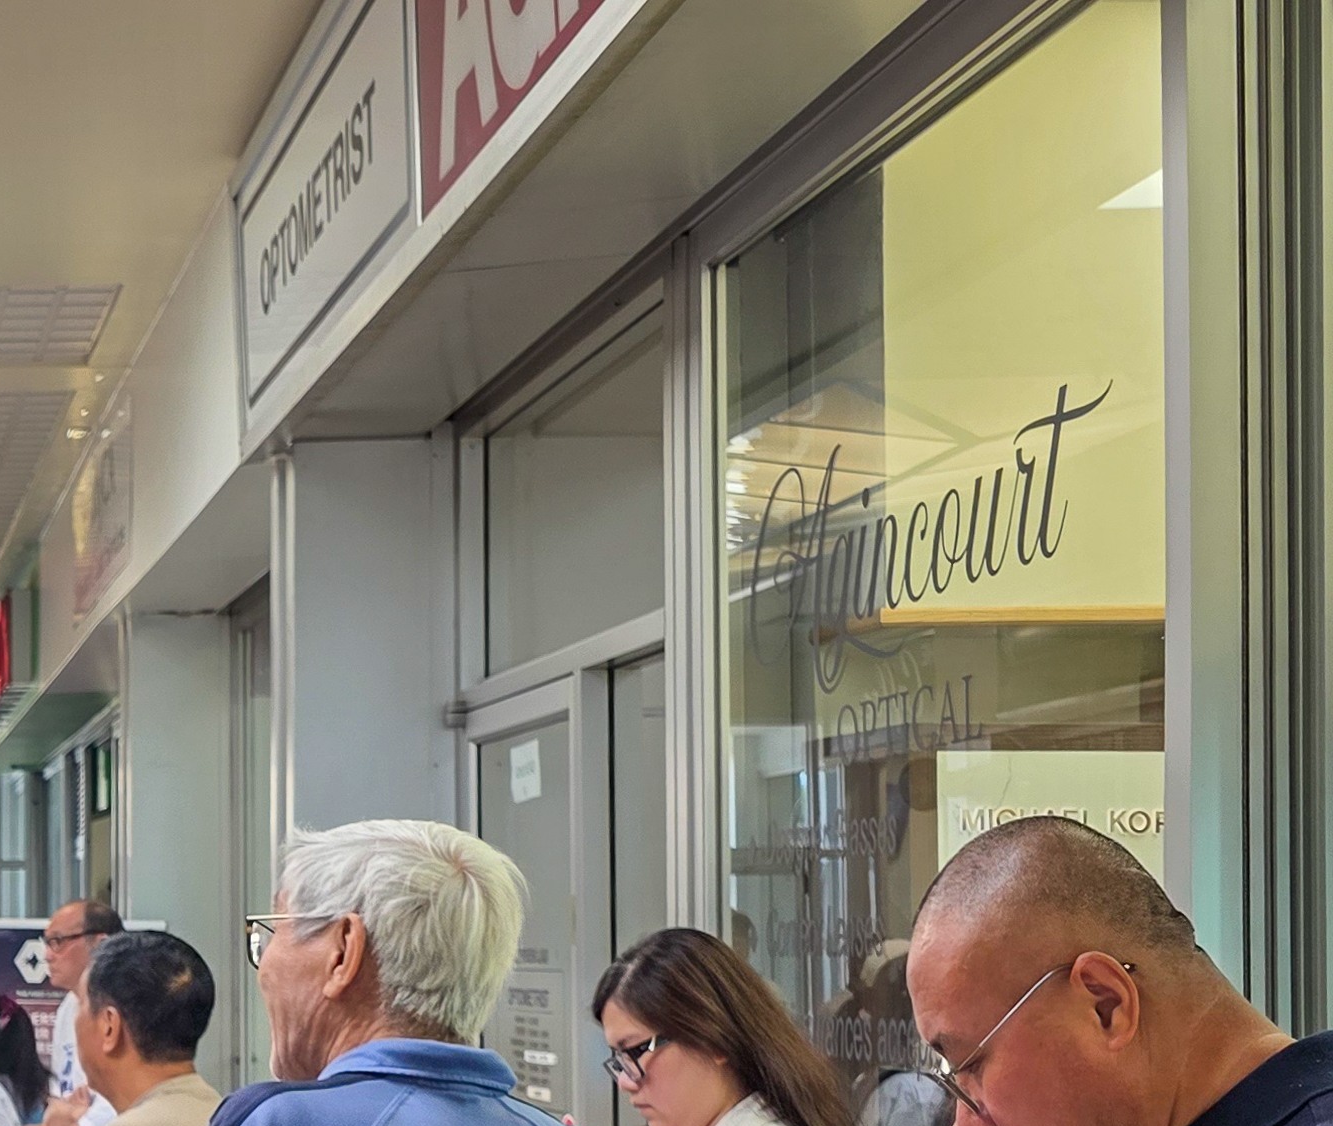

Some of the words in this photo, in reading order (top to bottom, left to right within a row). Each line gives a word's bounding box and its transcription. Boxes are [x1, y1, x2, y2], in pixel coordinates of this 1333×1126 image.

[259, 79, 377, 315] OPTOMETRIST
[750, 379, 1113, 694] Agincourt
[836, 673, 983, 766] OPTICAL
